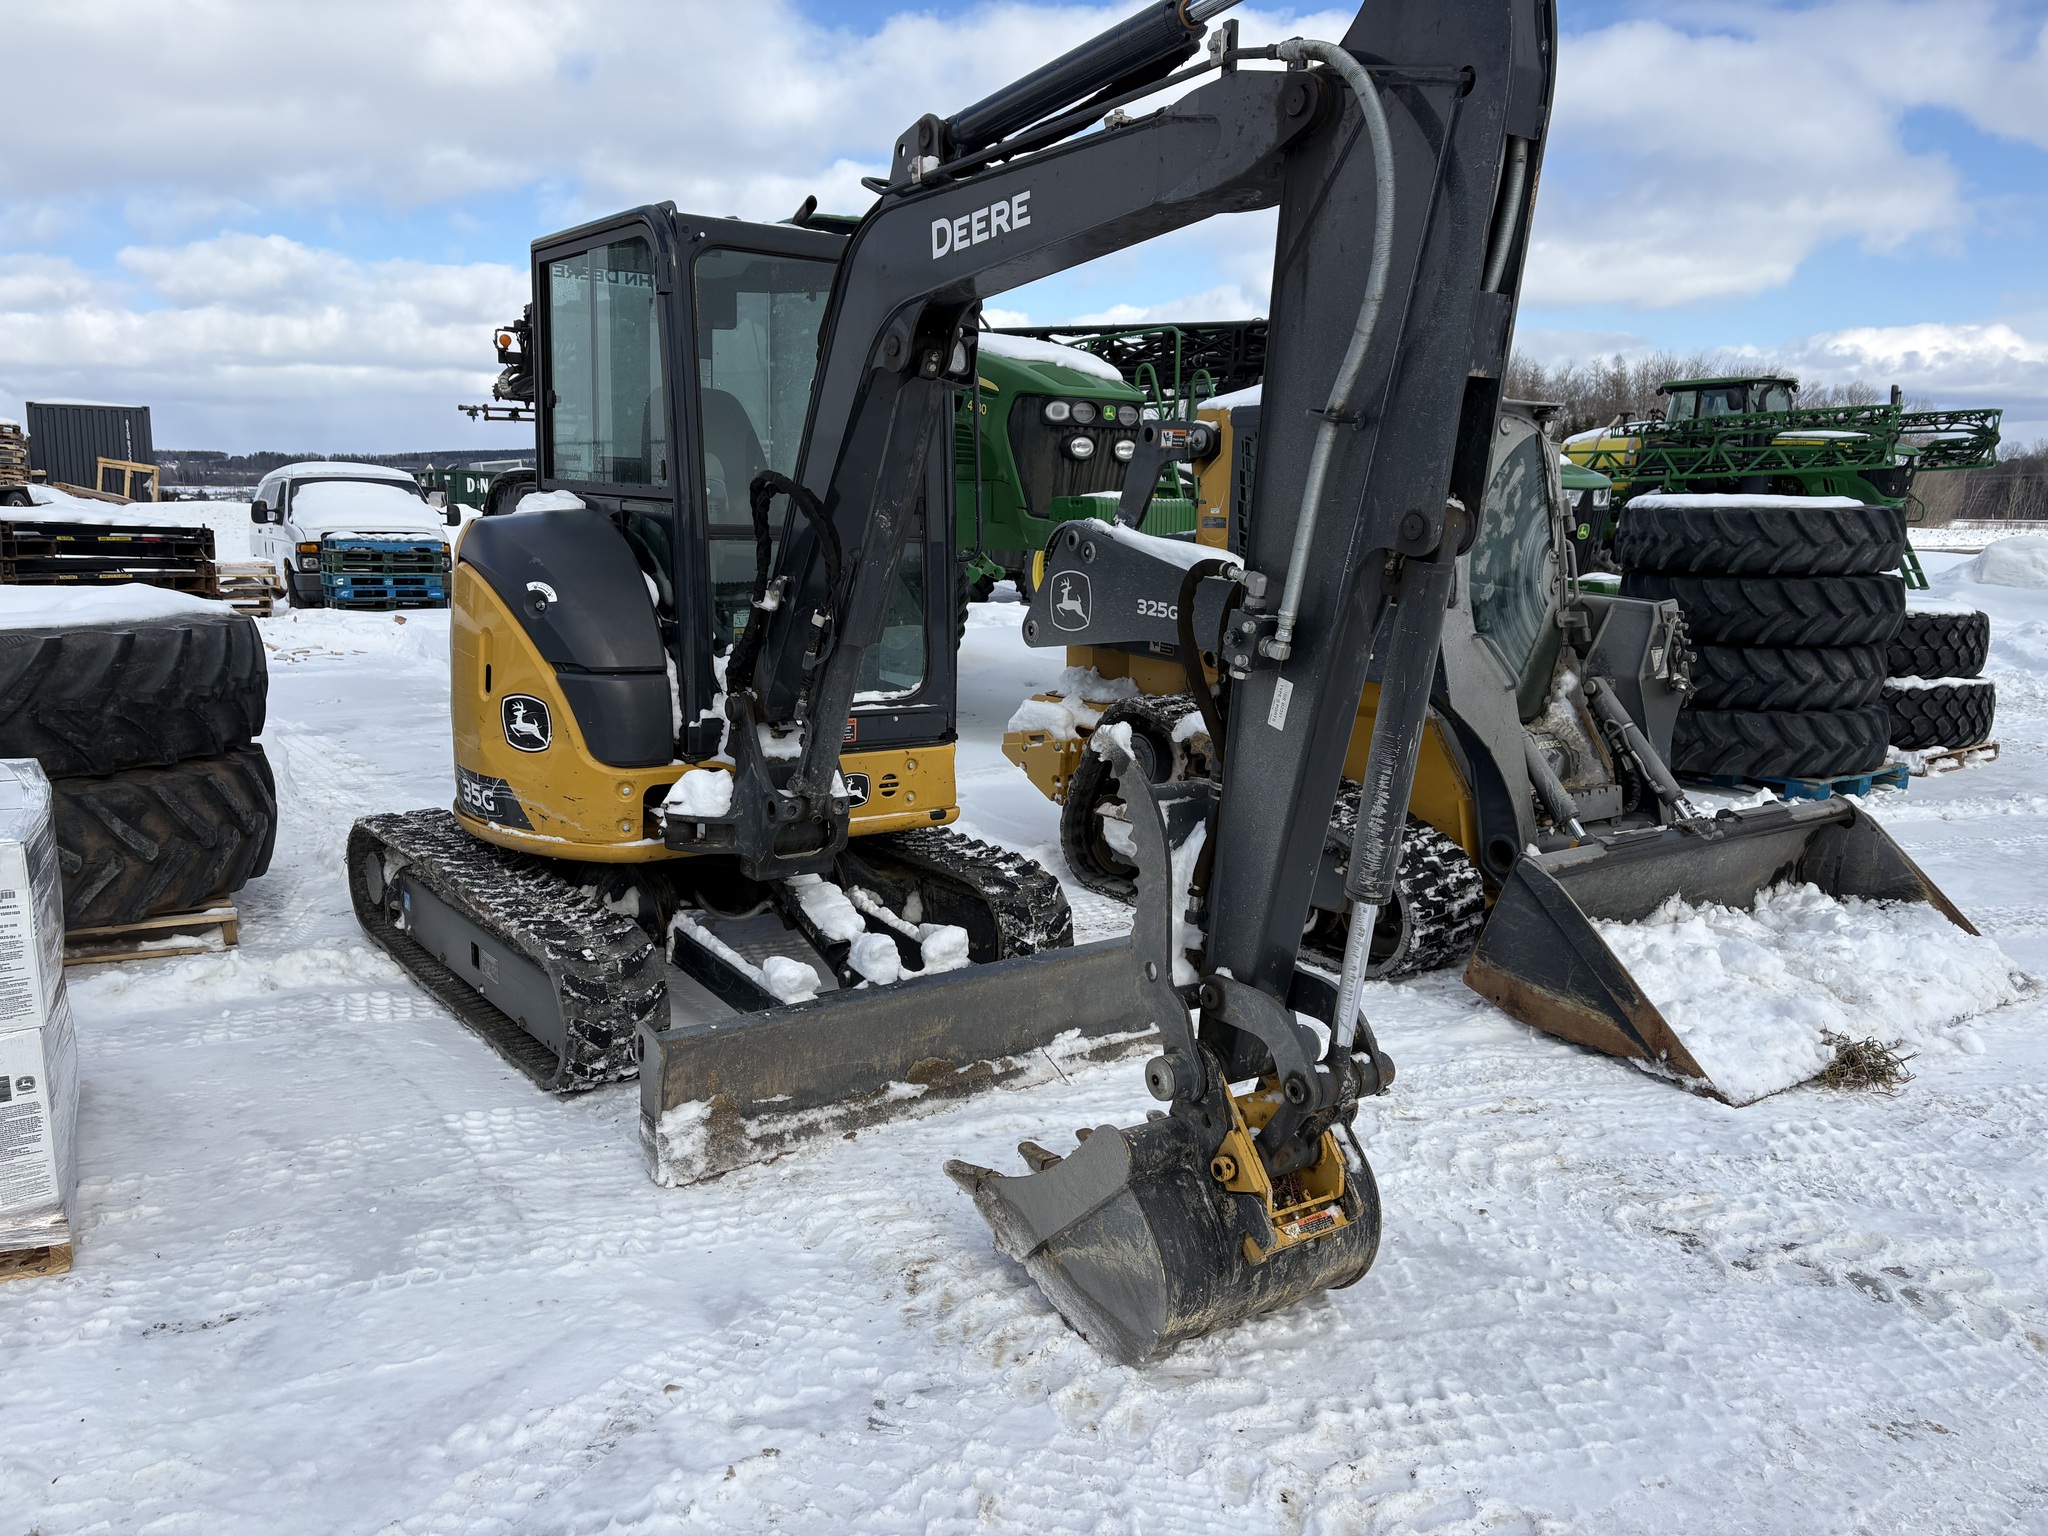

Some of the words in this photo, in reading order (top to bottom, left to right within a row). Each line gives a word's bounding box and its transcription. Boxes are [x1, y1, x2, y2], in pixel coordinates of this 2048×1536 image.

[931, 190, 1031, 260] DEERE
[1136, 598, 1178, 620] 325G
[1537, 740, 1562, 750] EERE
[462, 778, 495, 811] 35G
